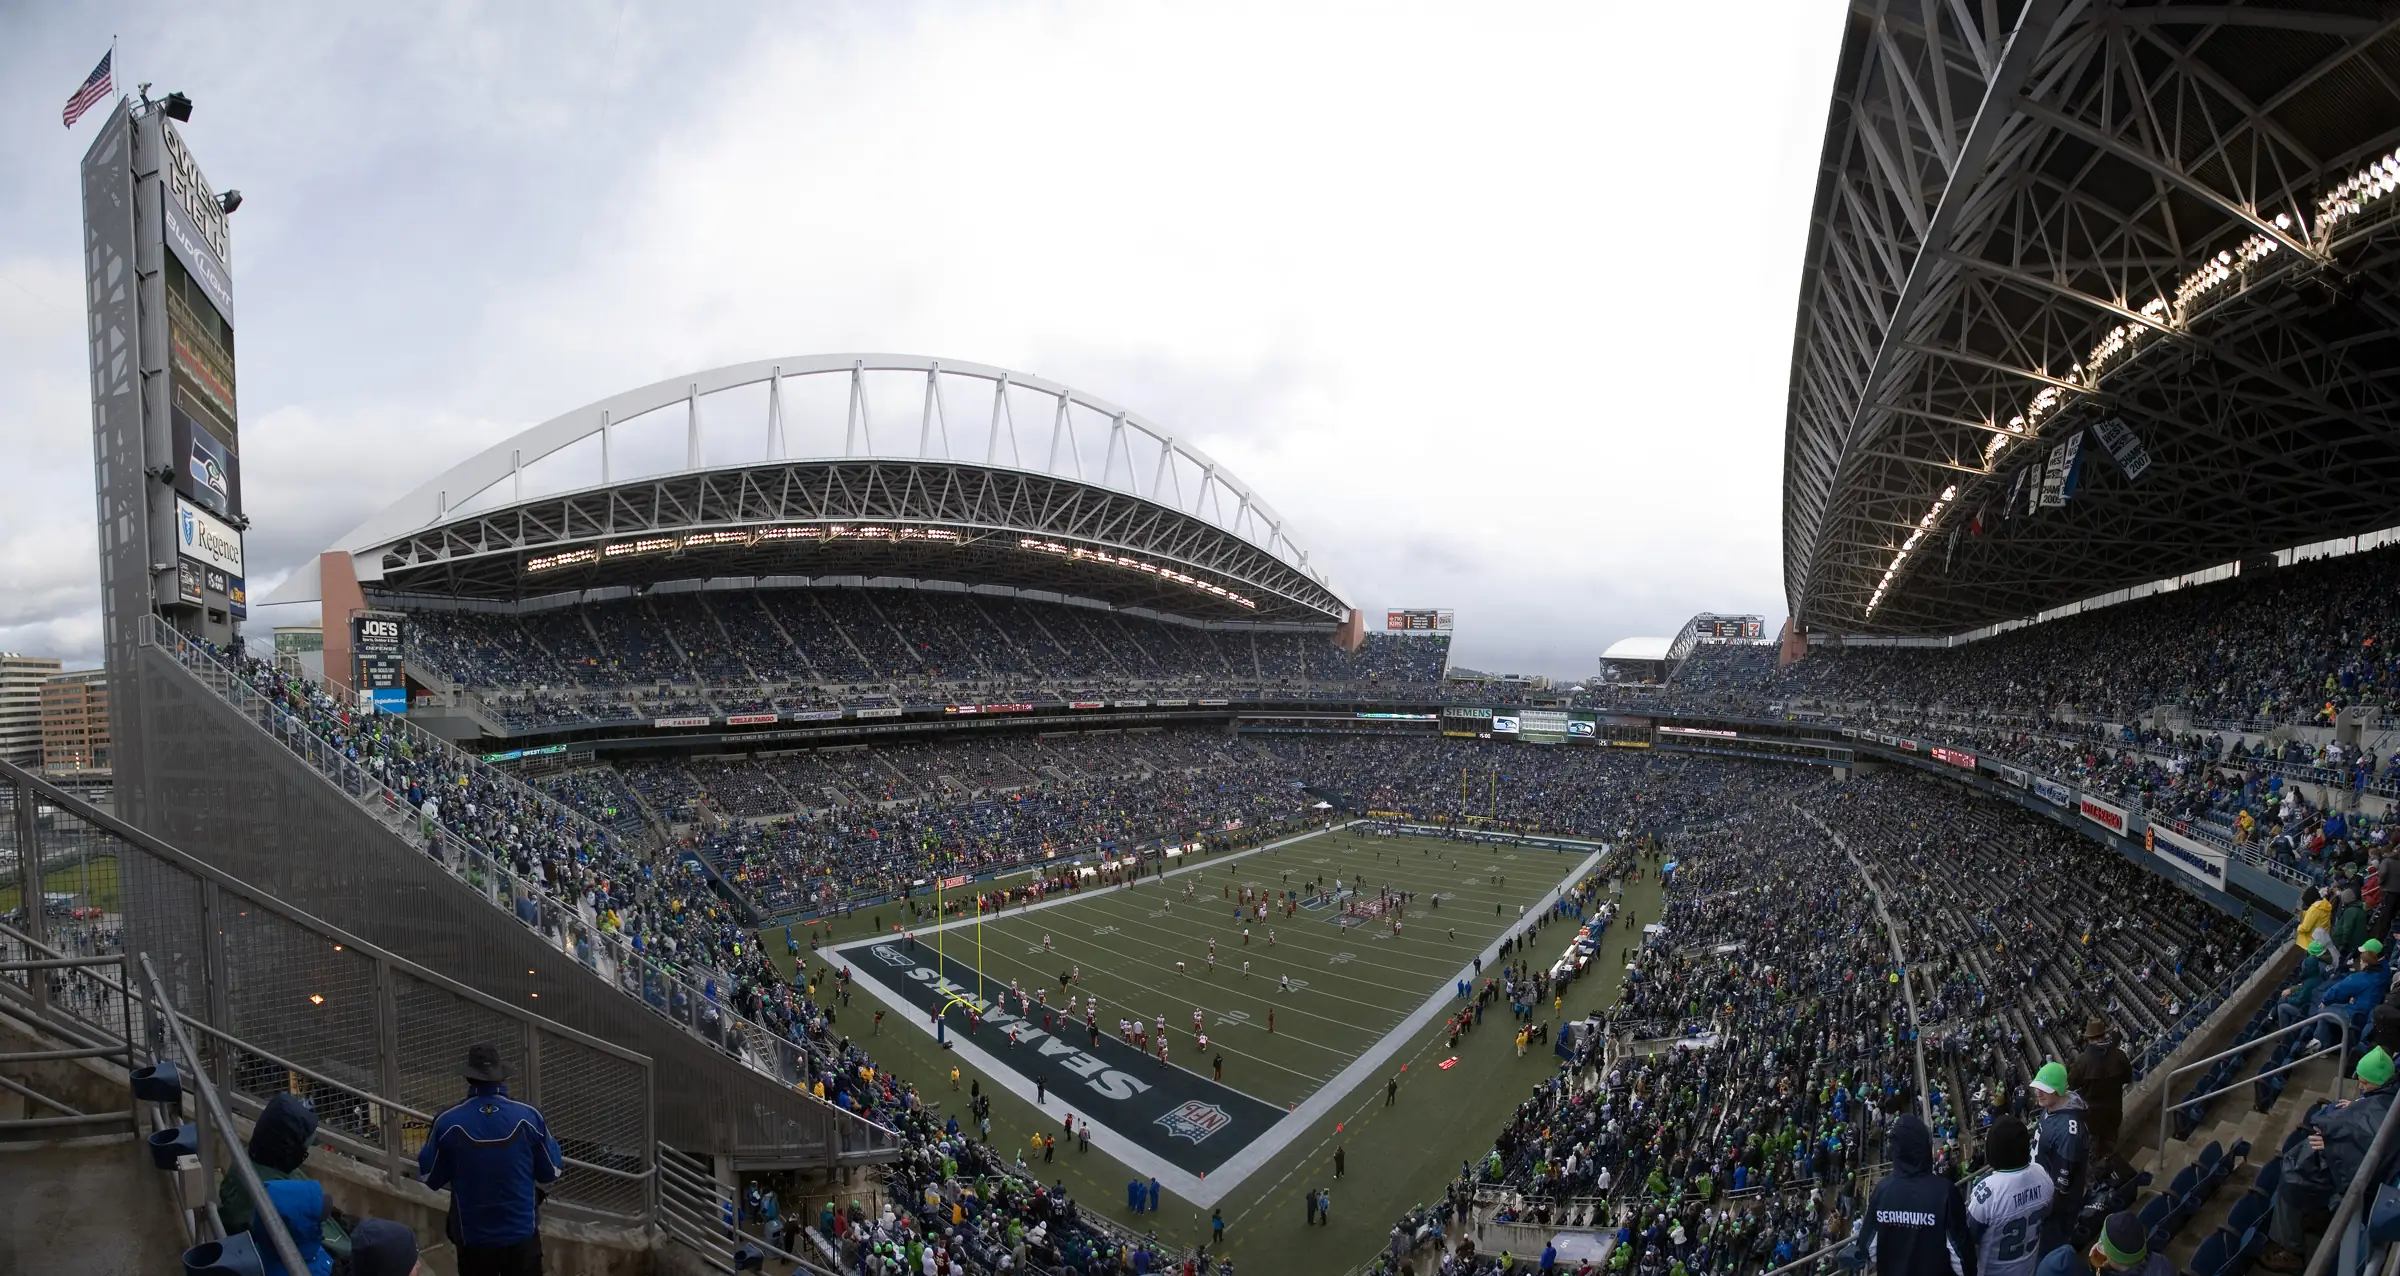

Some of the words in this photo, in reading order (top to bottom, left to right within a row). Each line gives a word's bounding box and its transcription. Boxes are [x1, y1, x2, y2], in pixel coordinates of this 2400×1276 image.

[162, 123, 229, 238] QWEST
[170, 162, 227, 264] FIELD
[166, 210, 195, 255] BUD
[198, 255, 232, 305] LIGHT
[2099, 421, 2115, 432] NFC
[2102, 424, 2124, 443] WEST
[2130, 453, 2149, 474] 2007
[197, 519, 239, 564] Regence
[362, 621, 398, 636] JOE'S
[753, 715, 775, 723] FARGO
[1446, 708, 1491, 718] SIEMENS
[2081, 800, 2100, 819] WELLS
[2100, 809, 2122, 830] FARGO
[1217, 1010, 1250, 1026] 10
[905, 967, 1152, 1100] SEAHAWKS
[1184, 1104, 1226, 1129] NFL
[2068, 1119, 2078, 1135] 8
[1973, 1181, 1992, 1204] 23
[2013, 1185, 2042, 1208] TRUFANT
[1876, 1211, 1936, 1226] SEAHAWKS
